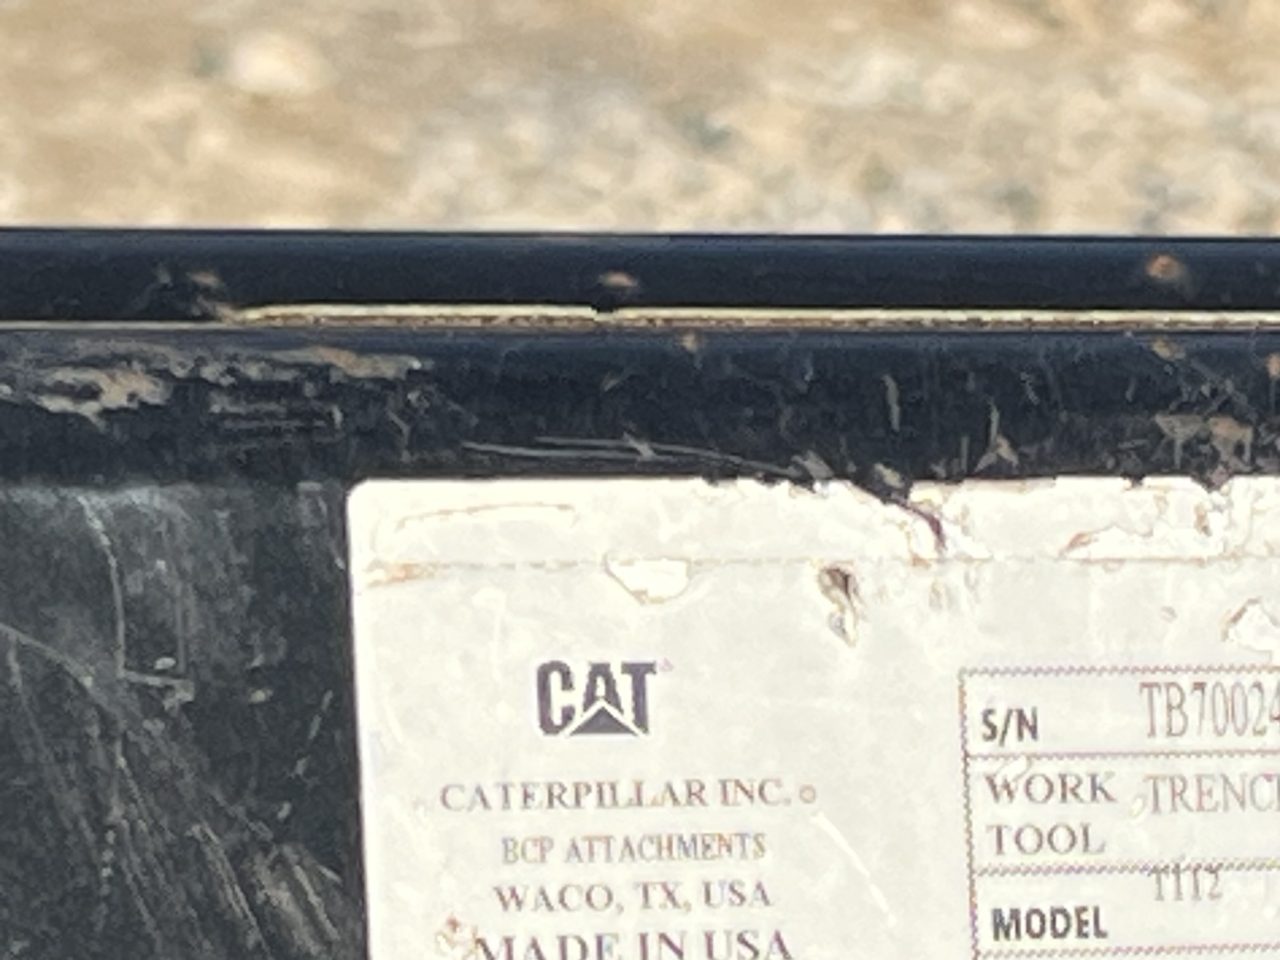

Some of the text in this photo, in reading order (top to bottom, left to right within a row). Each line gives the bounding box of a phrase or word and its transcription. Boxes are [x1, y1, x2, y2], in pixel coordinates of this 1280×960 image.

[536, 659, 657, 736] CAT
[981, 706, 1039, 747] S/N
[440, 778, 708, 812] CATERPILLAR
[985, 772, 1118, 804] WORK
[501, 830, 766, 865] BCP ATTACHMENTS
[986, 822, 1107, 857] TOOL
[494, 880, 774, 914] WACO, TX, USA
[991, 907, 1108, 942] MODEL
